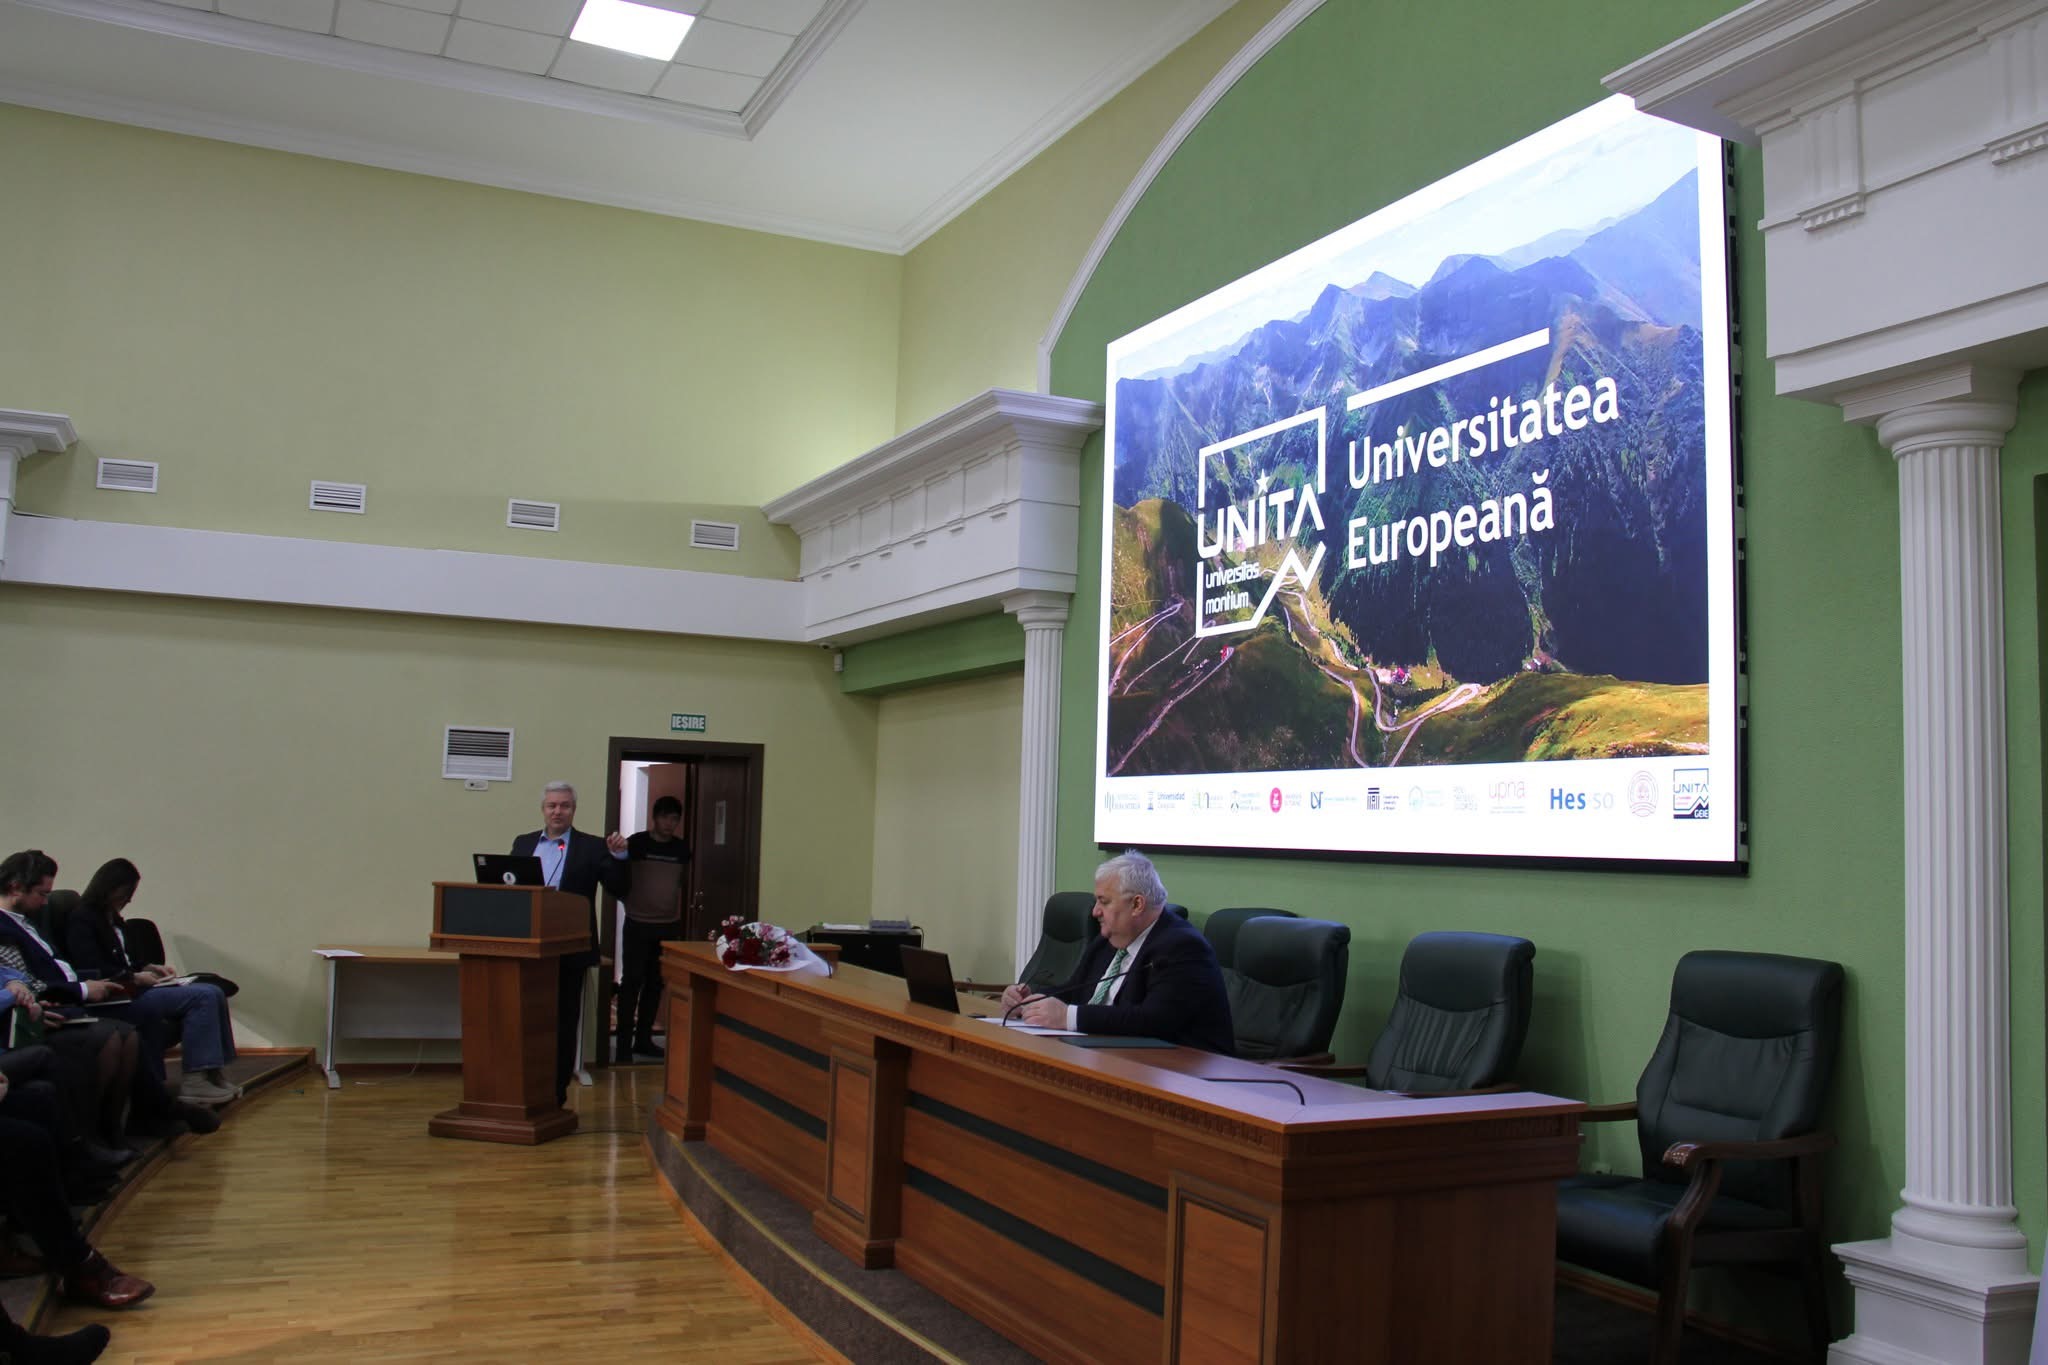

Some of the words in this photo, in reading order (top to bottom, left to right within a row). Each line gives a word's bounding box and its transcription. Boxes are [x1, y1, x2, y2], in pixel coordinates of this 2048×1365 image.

[1348, 375, 1619, 490] Universitatea
[1197, 482, 1326, 559] UNITA
[1348, 468, 1555, 570] Europeană
[1205, 560, 1260, 589] universitas
[1205, 590, 1249, 615] montium
[1550, 788, 1587, 810] Hes
[1673, 783, 1709, 794] UNITA
